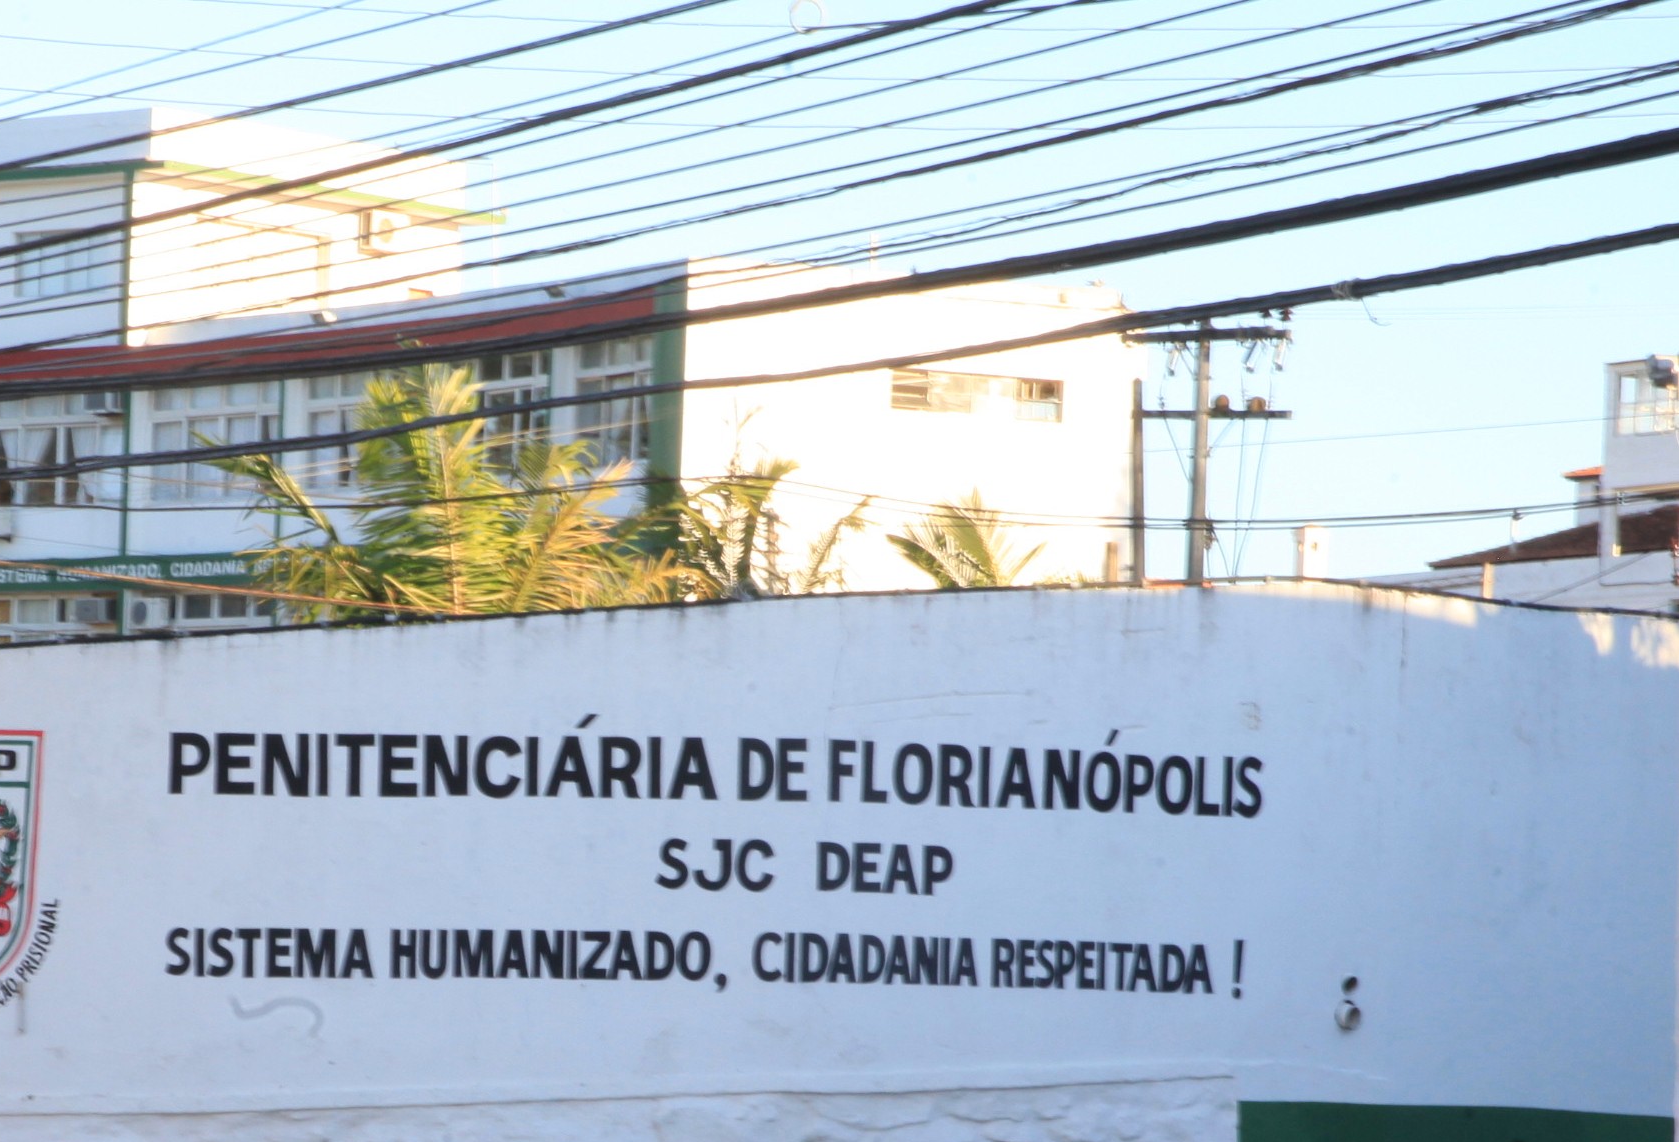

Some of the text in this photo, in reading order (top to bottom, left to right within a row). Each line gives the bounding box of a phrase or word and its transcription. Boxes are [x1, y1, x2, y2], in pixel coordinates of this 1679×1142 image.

[170, 559, 246, 577] CIDADANIA
[167, 711, 1265, 820] PENITENCIÁRIA DE FLORIANÓPOLIS
[654, 836, 956, 897] SJC DEAP
[15, 898, 61, 983] PRISIONAL
[165, 925, 376, 980] SISTEMA
[389, 927, 729, 993] HUMANIZADO,
[751, 930, 979, 988] CIDADANIA
[989, 936, 1215, 995] RESPEITADA
